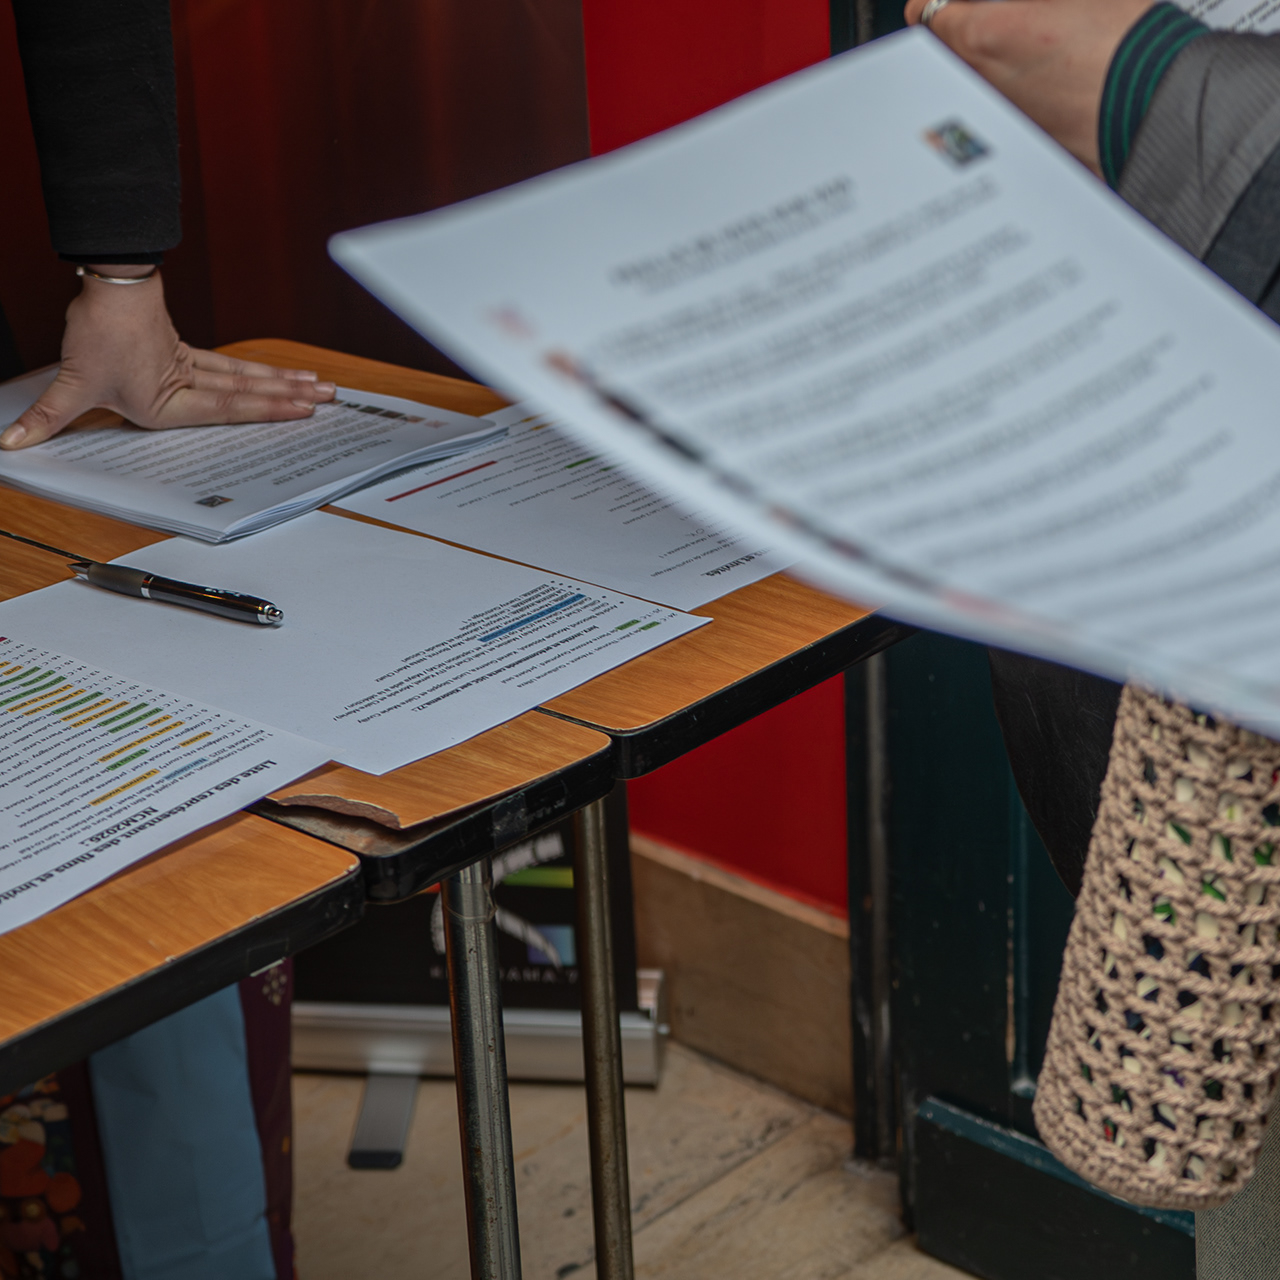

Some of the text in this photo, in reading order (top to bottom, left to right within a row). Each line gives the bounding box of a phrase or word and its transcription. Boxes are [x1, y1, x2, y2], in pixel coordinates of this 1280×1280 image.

[241, 760, 278, 778] Liste
[214, 777, 244, 792] des
[118, 789, 217, 840] représentant
[93, 837, 123, 854] des
[53, 852, 96, 873] films
[32, 871, 56, 883] et
